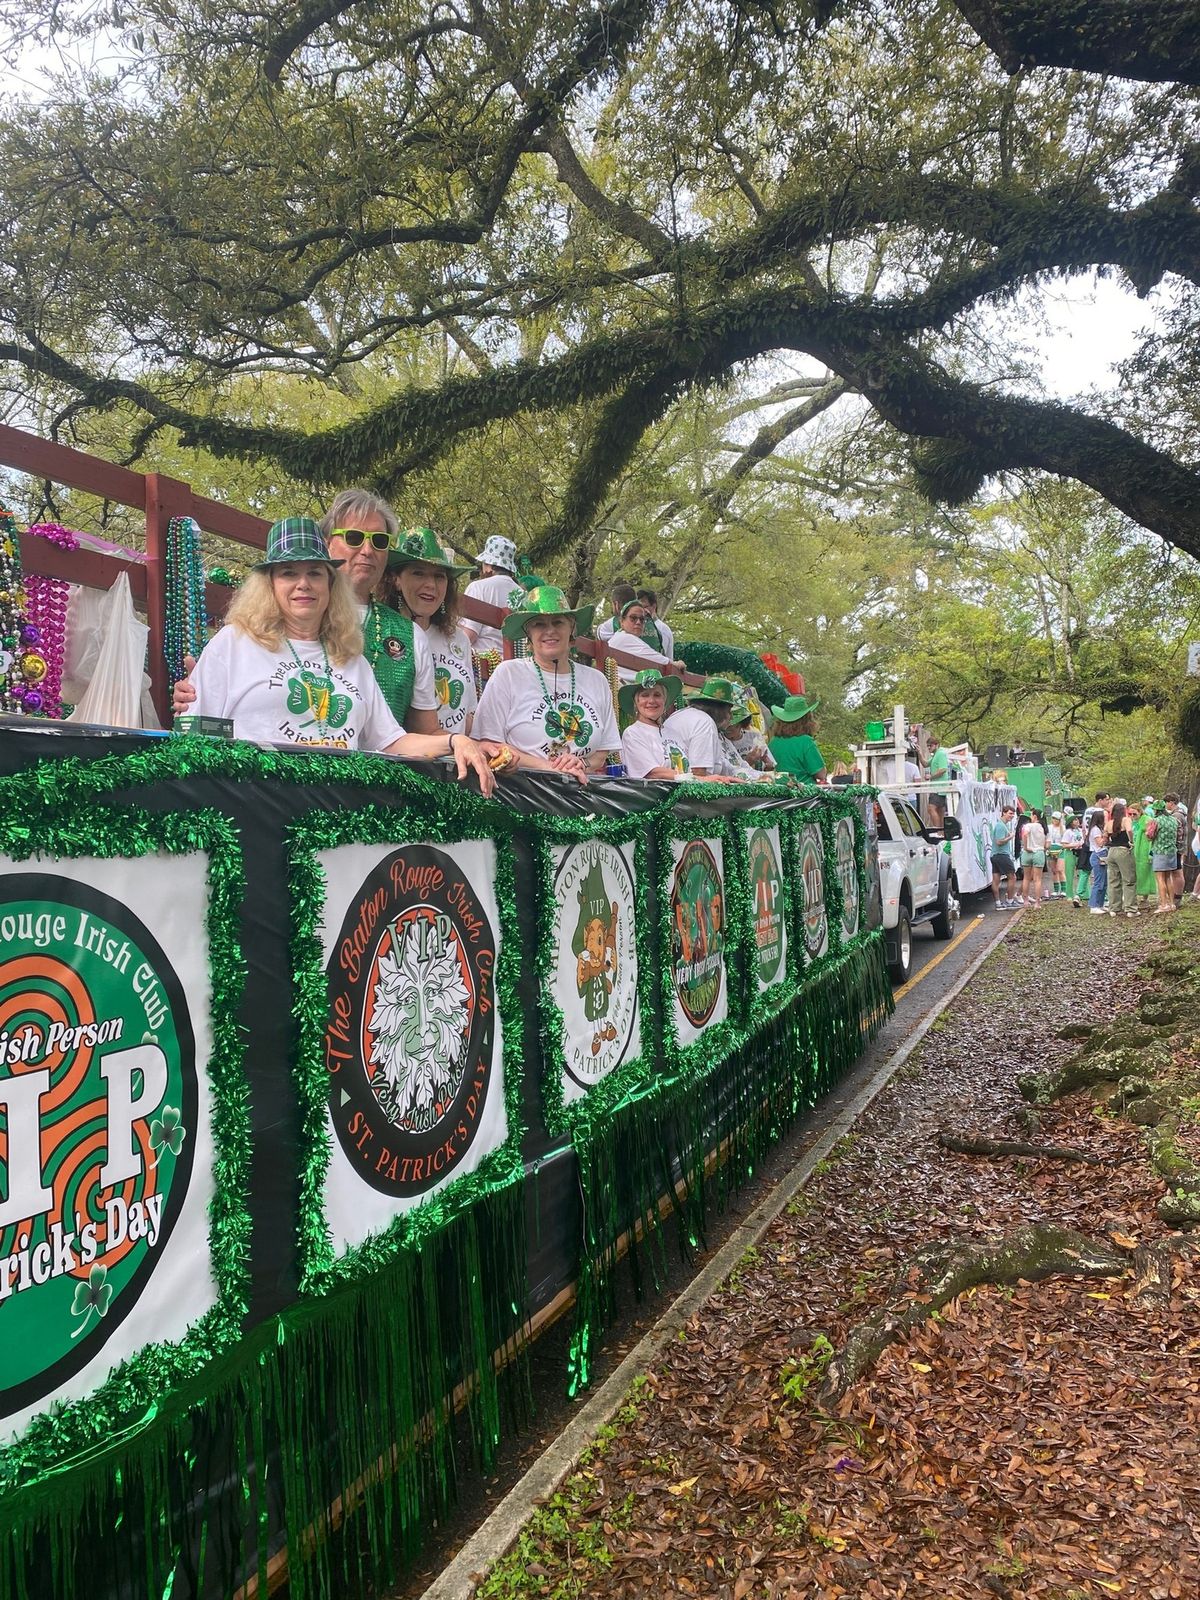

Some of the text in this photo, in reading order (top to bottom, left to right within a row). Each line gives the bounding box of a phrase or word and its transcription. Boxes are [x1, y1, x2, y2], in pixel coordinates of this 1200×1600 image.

[280, 660, 322, 672] Baon
[610, 854, 631, 902] IRISH
[589, 898, 606, 916] VIP
[325, 858, 494, 1073] The Baton Rouge Irish Club
[386, 914, 453, 969] VIP
[0, 912, 169, 1030] ouge Irish Club
[45, 1017, 124, 1056] Person
[347, 1056, 487, 1182] ST. PATRICK'S DAY
[370, 1071, 400, 1124] Very
[403, 1104, 439, 1133] Irish
[104, 1193, 164, 1252] Day
